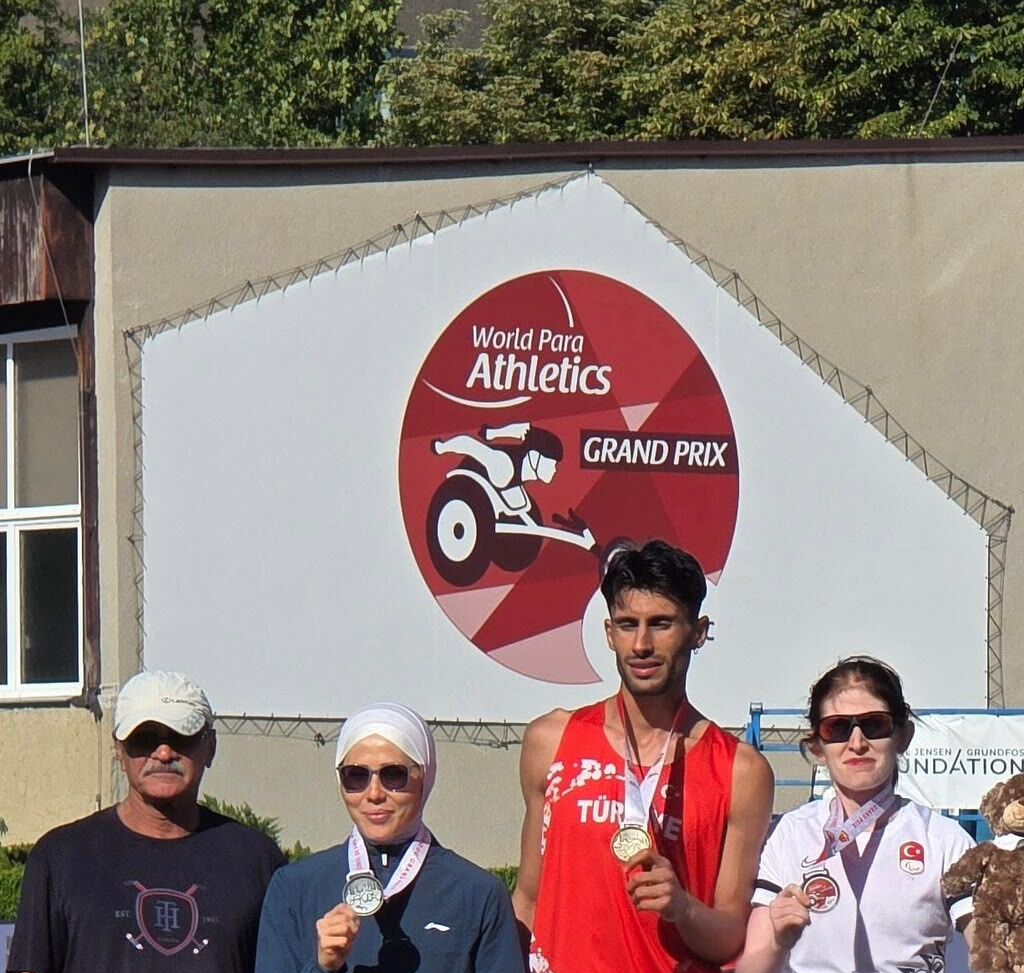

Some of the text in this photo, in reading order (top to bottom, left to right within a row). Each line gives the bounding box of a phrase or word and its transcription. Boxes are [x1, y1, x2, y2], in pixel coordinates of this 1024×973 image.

[472, 325, 585, 353] World Para
[466, 353, 612, 395] Athletics
[584, 437, 728, 468] GRAND PRIX
[914, 748, 952, 756] JENSEN
